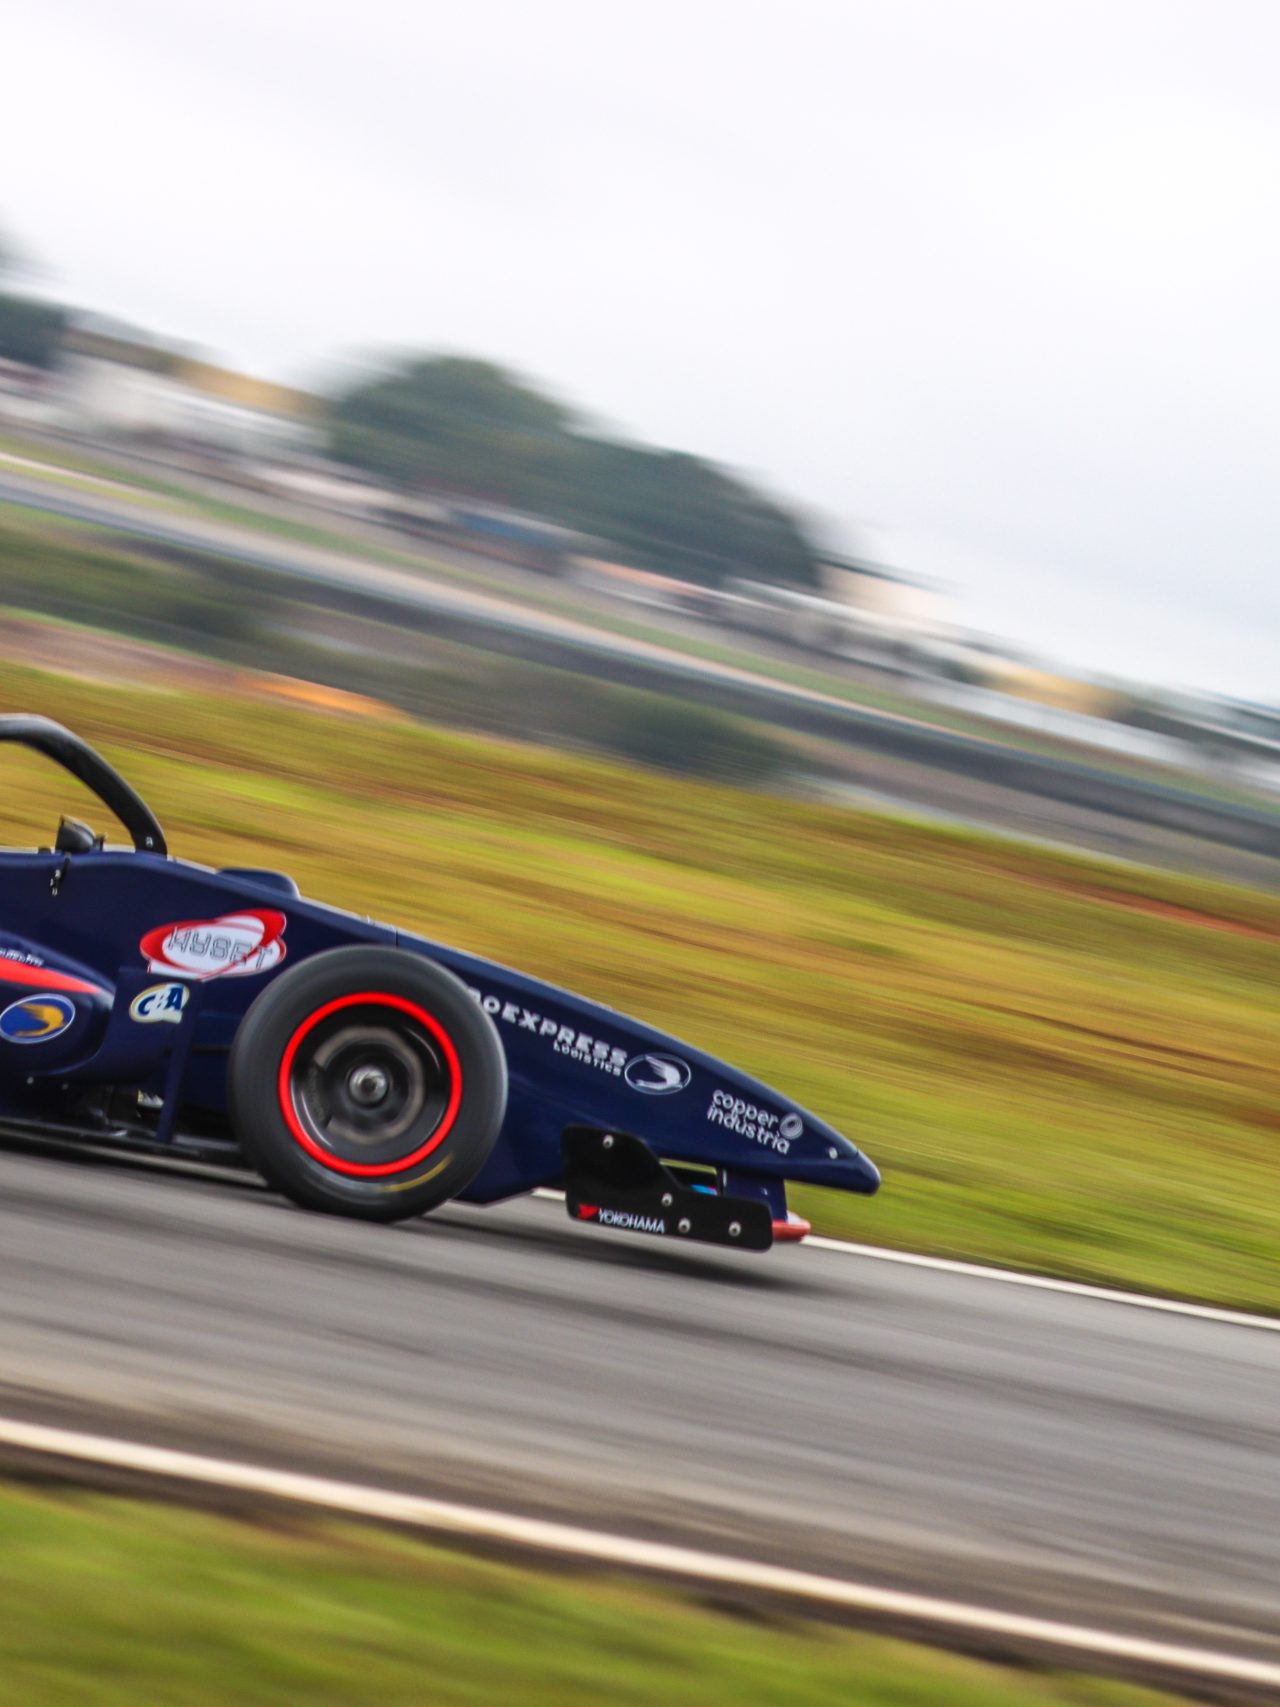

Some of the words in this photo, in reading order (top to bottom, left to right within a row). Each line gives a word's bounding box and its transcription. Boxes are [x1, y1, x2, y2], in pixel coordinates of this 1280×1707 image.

[553, 1039, 621, 1077] LOGISTICS
[712, 1089, 779, 1129] copper
[599, 1207, 665, 1234] YOKOHAMA
